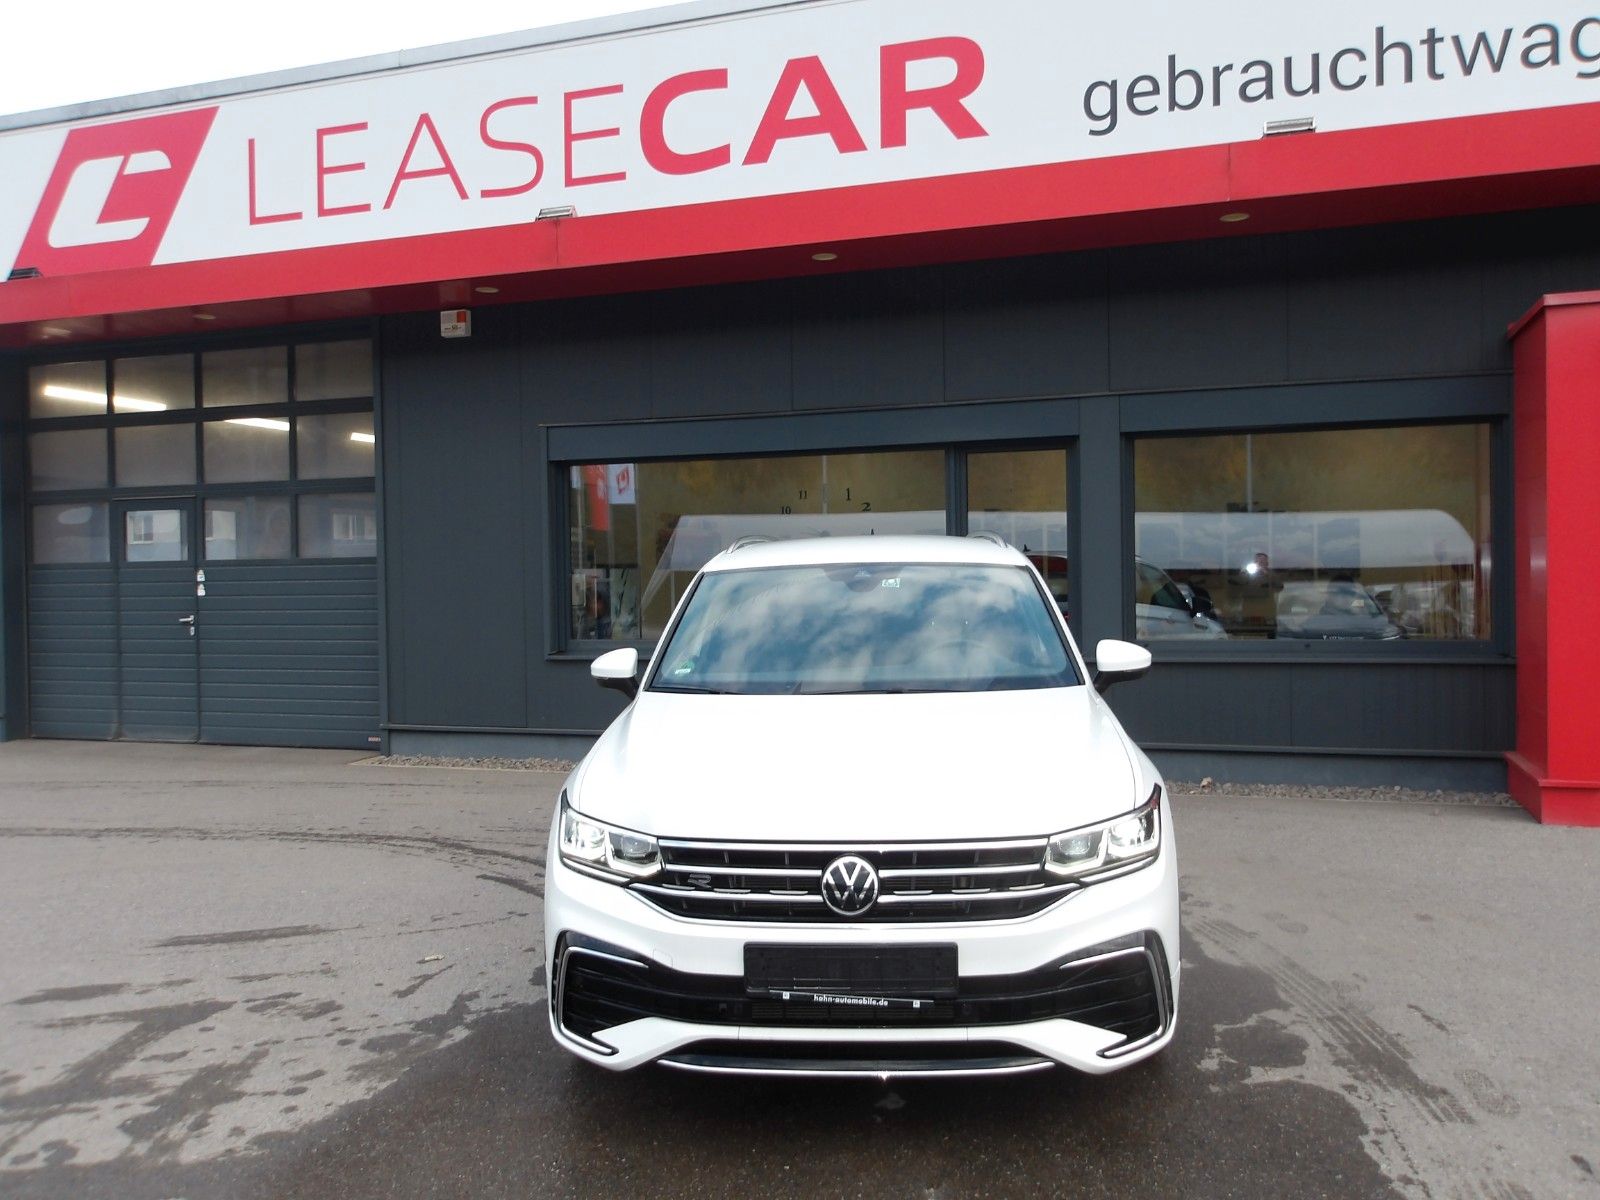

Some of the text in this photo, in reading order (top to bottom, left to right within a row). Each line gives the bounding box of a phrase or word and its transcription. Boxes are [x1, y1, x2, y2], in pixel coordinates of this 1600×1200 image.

[1083, 17, 1600, 136] gebrauchtwag
[248, 36, 989, 226] LEASECAR
[799, 489, 808, 500] 11
[845, 487, 851, 501] 1
[781, 505, 791, 515] 10
[861, 502, 872, 512] 2
